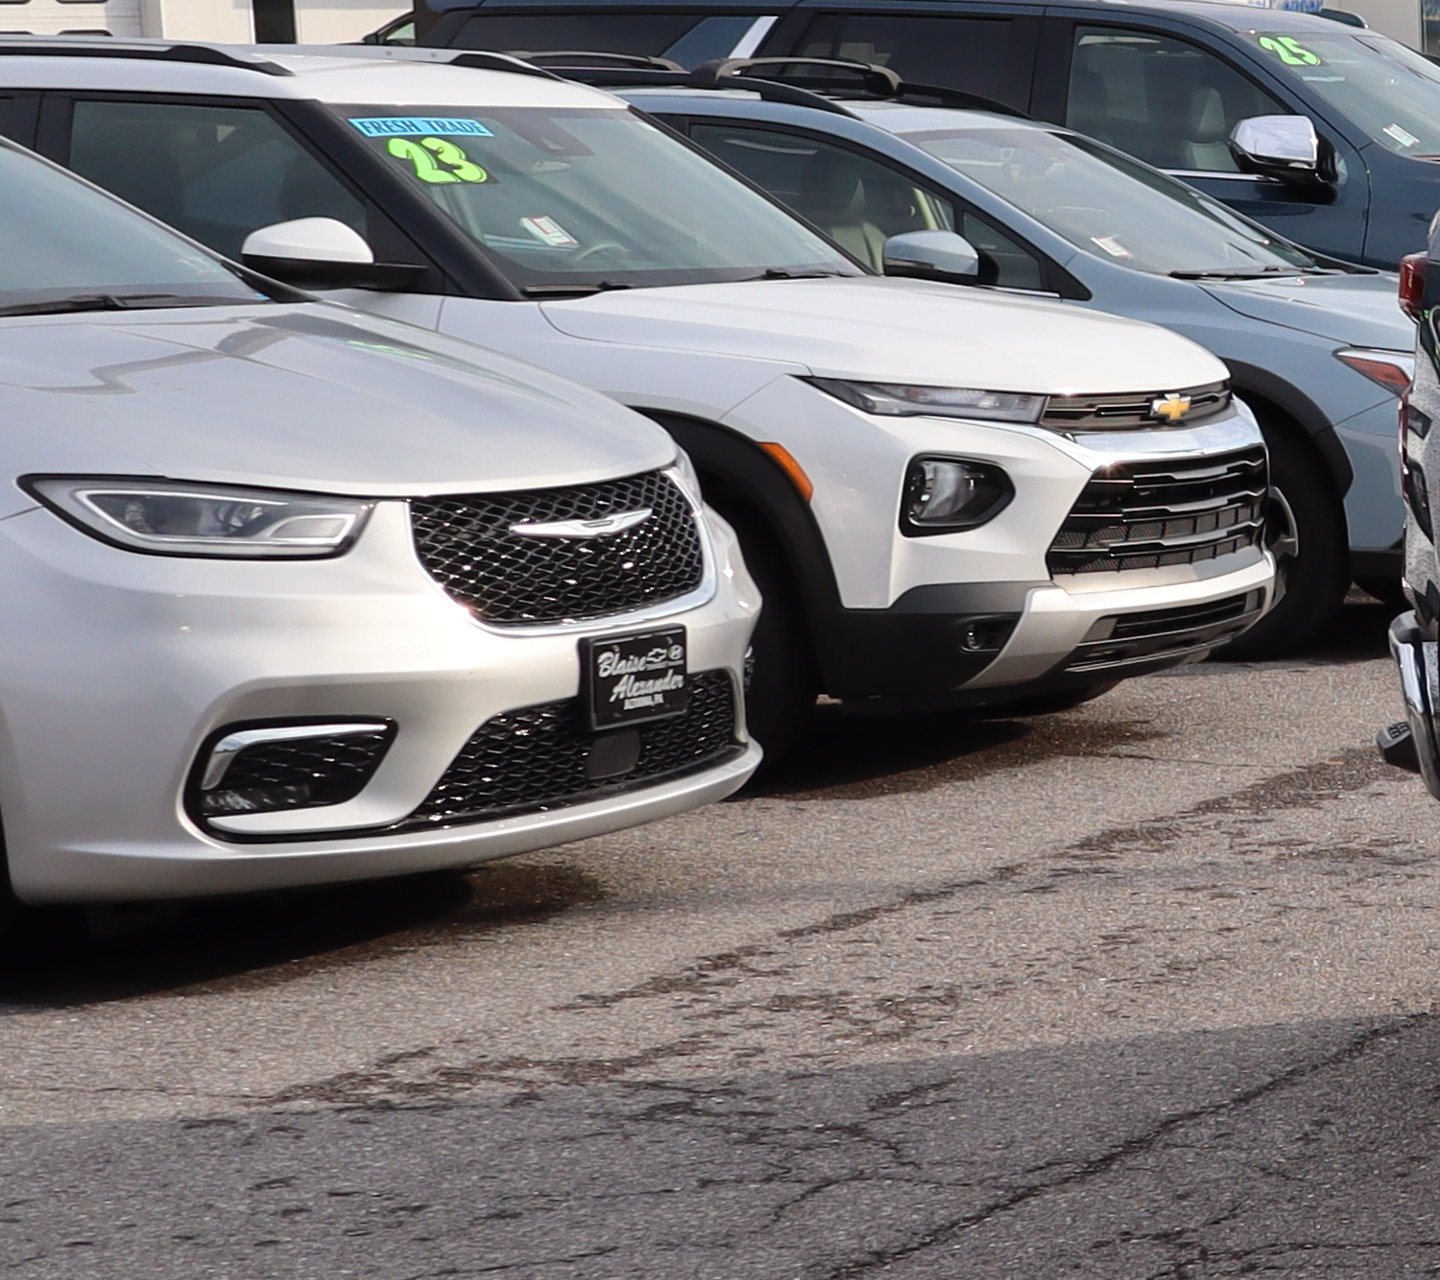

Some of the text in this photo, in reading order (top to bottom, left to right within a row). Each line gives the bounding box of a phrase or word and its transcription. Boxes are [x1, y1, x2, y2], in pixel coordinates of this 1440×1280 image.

[1259, 36, 1322, 66] 25
[357, 119, 488, 135] FRESH TRADE
[386, 136, 489, 184] 23
[597, 649, 648, 678] Blaise
[608, 669, 685, 703] Alexander
